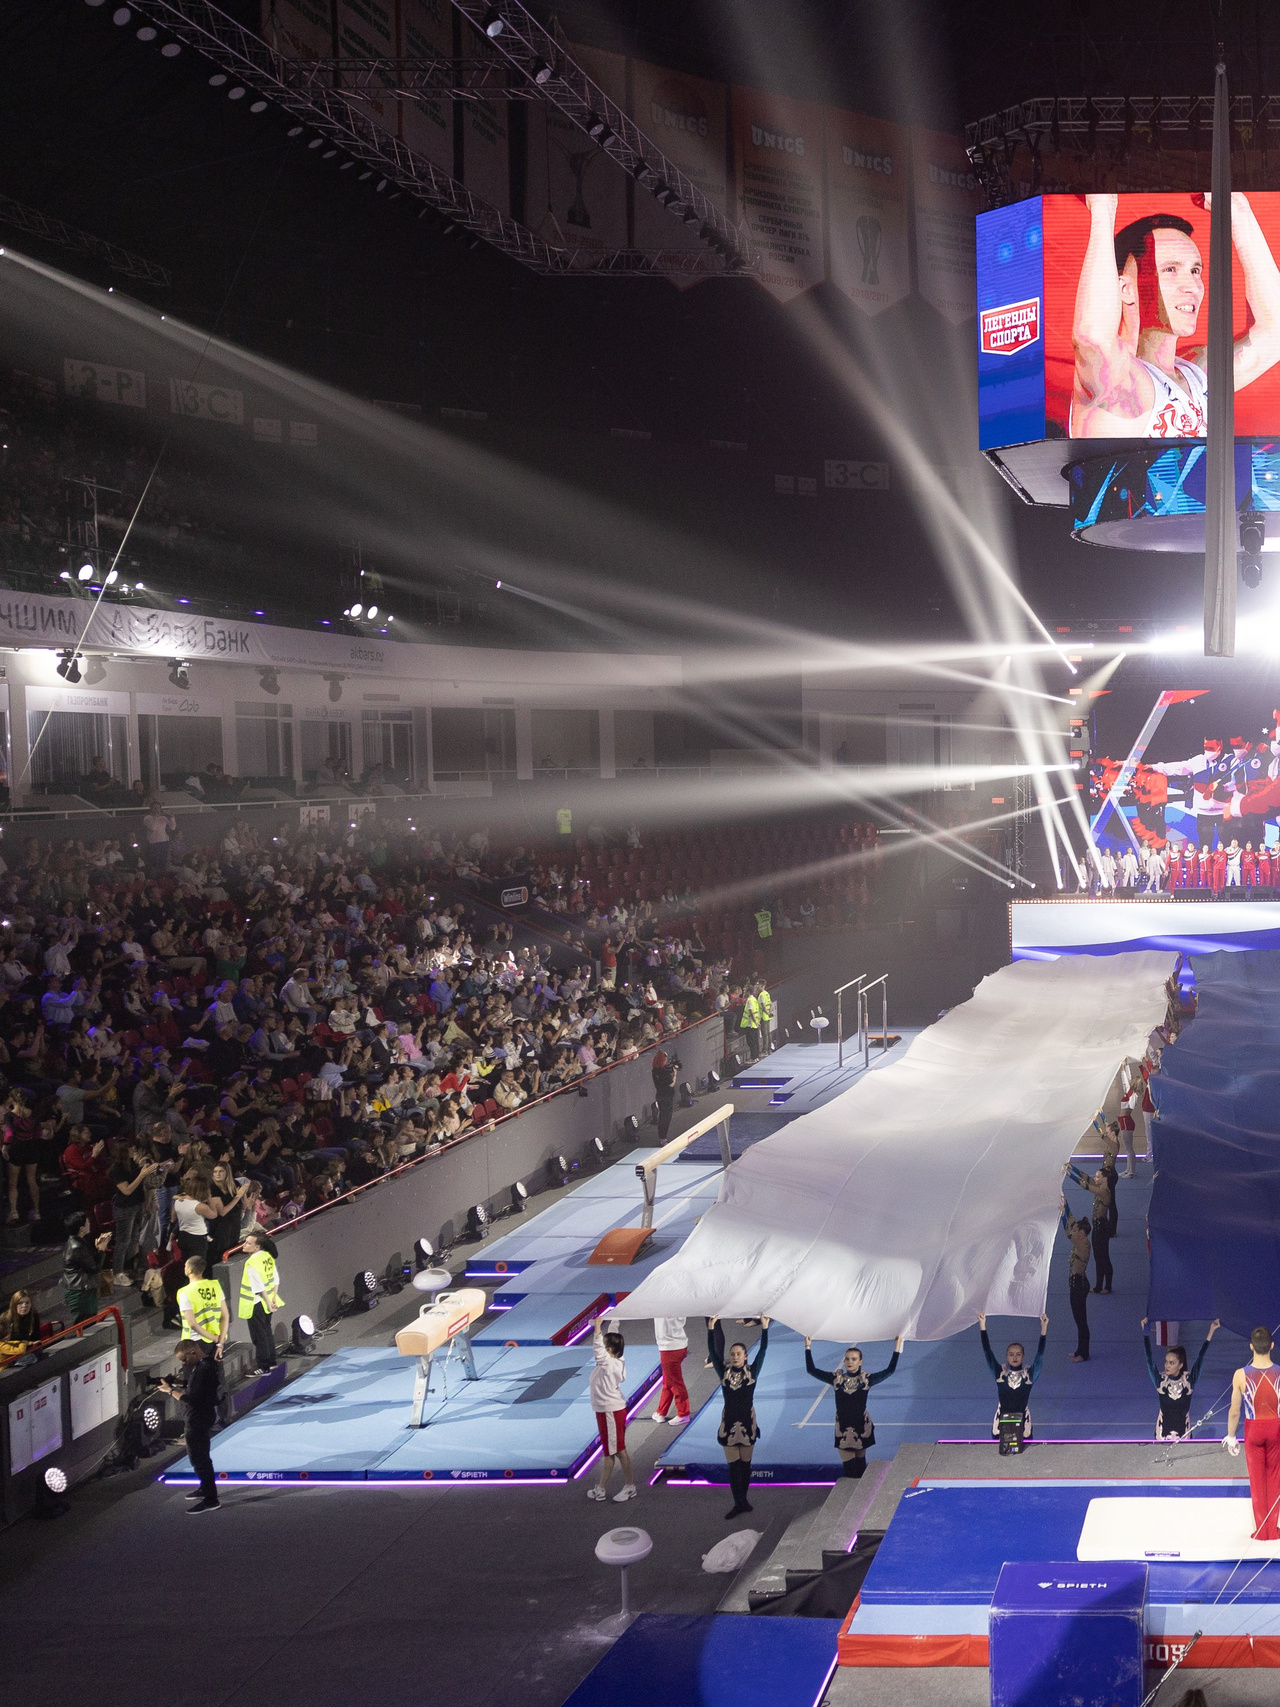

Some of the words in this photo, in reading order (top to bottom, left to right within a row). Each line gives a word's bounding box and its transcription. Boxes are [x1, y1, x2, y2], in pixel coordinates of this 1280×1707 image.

[651, 102, 708, 136] UNICS
[752, 124, 805, 156] UNICS
[842, 146, 892, 175] UNICS
[928, 162, 976, 190] UNICS
[984, 306, 1037, 333] ЛЕГЕНДЫ
[990, 325, 1031, 348] СПОРТА
[203, 621, 250, 653] Банк
[67, 696, 108, 707] ГАЗПРОМБАНК
[256, 1471, 283, 1480] SPIETH
[461, 1470, 488, 1478] SPIETH
